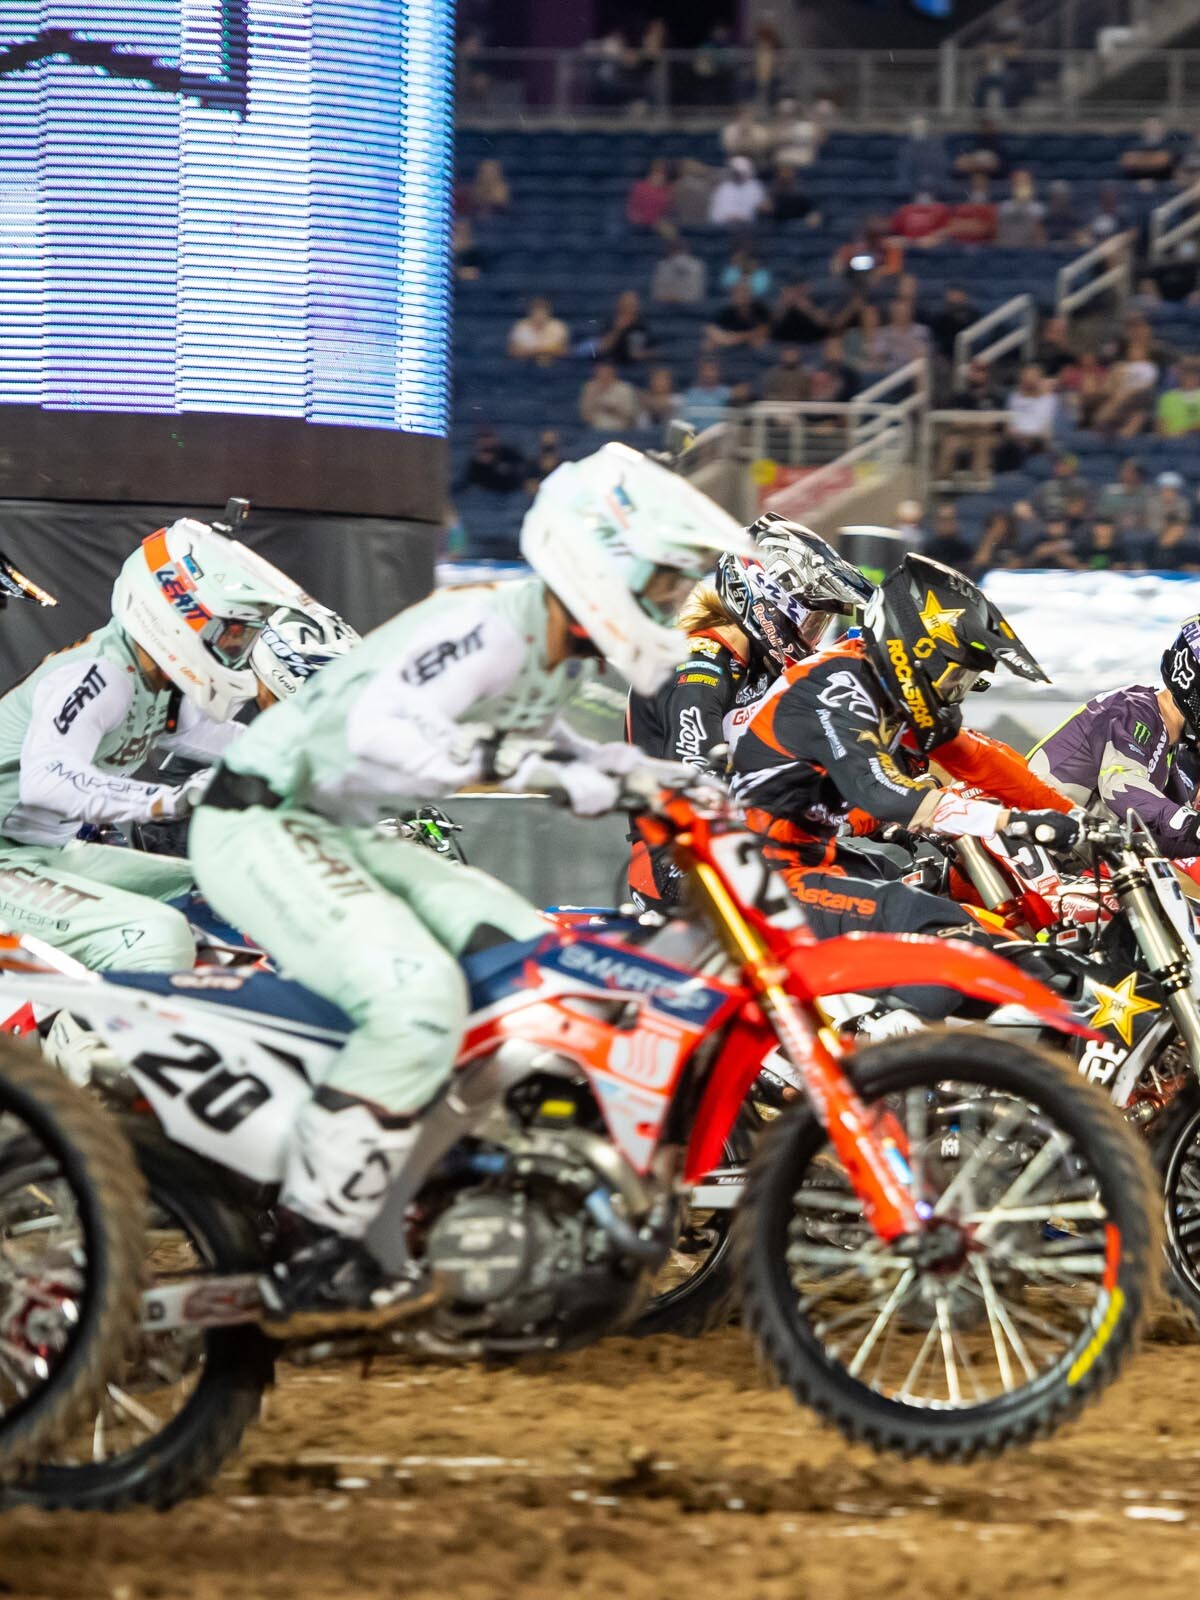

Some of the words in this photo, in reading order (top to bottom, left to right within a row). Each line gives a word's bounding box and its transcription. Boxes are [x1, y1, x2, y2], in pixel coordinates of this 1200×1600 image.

[156, 570, 212, 620] LEATT
[401, 621, 485, 685] LEATT
[886, 639, 935, 728] ROCKSTAR
[53, 663, 107, 736] LEATT
[132, 1031, 273, 1133] 20
